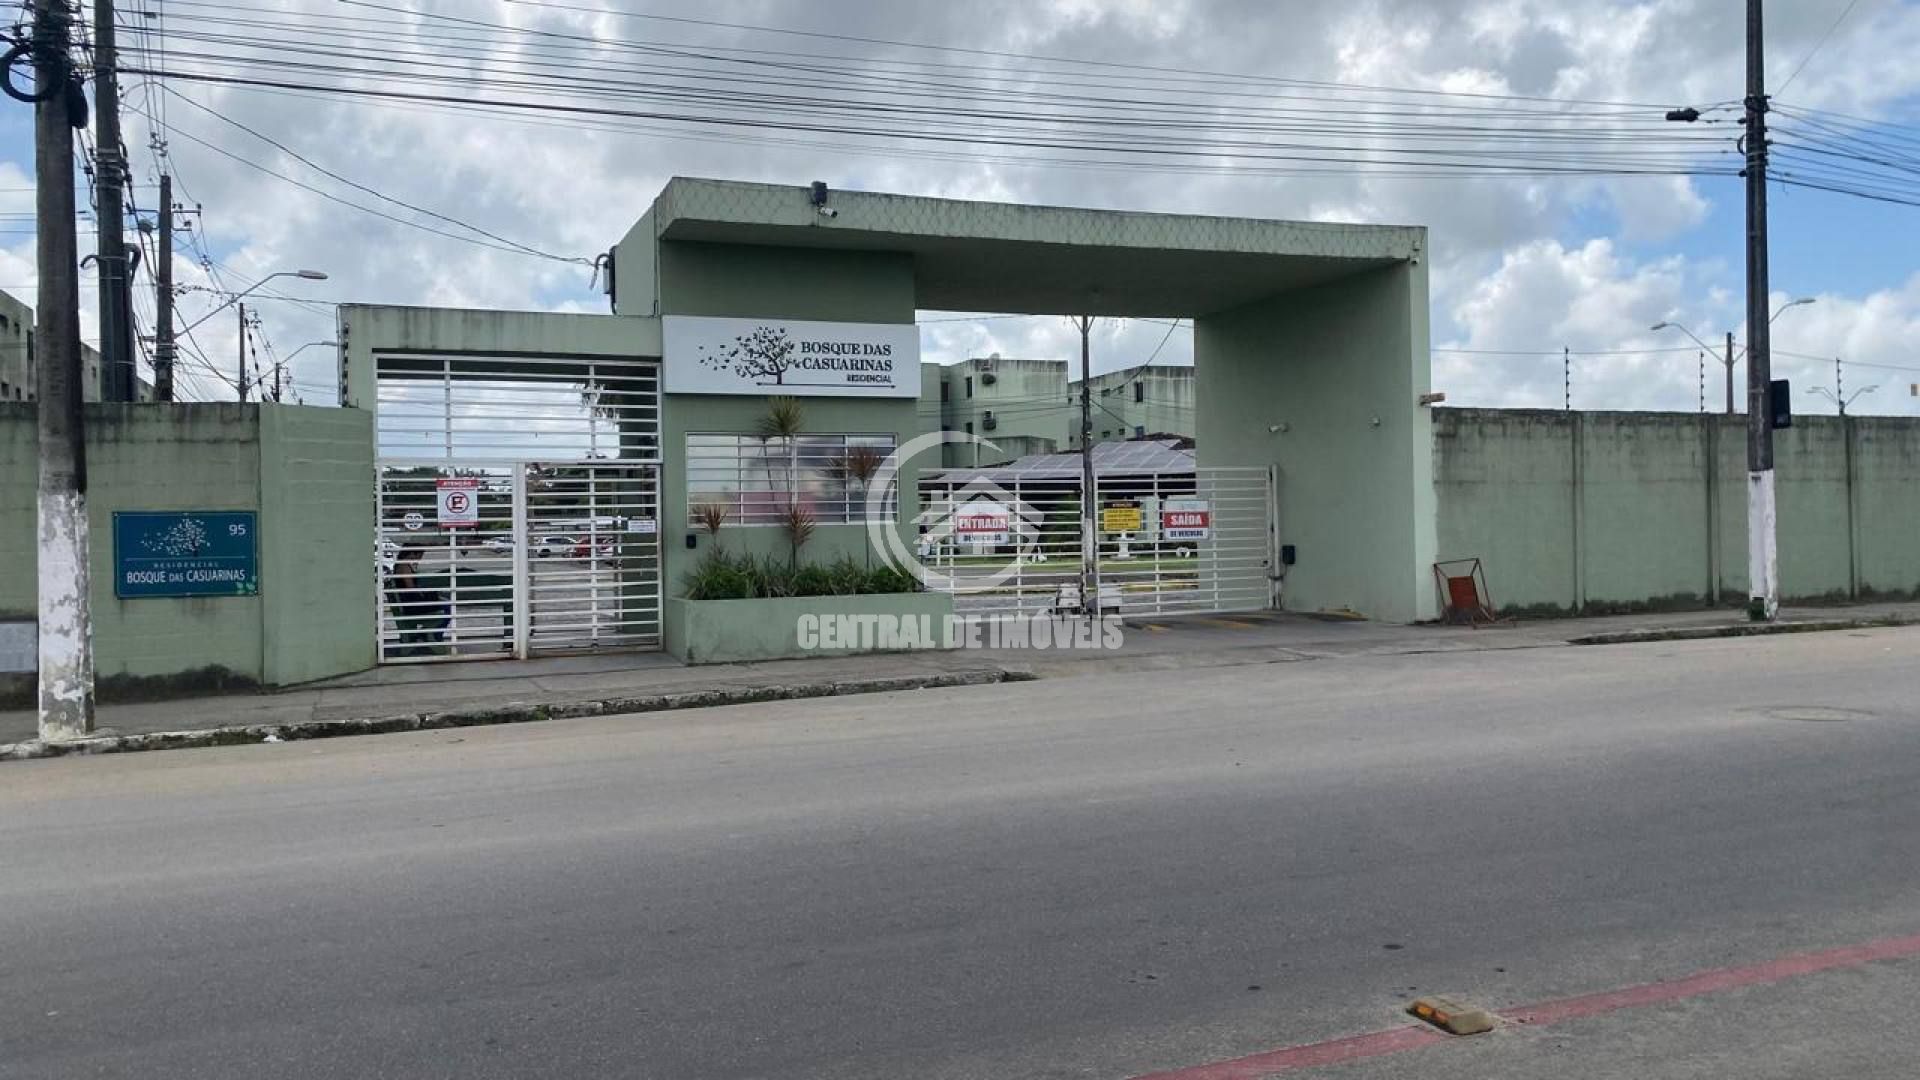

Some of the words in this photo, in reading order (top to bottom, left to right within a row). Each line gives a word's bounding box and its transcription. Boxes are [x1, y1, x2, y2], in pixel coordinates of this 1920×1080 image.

[801, 341, 860, 356] BOSQUE
[863, 343, 892, 356] DAS
[802, 357, 893, 372] CASUARINAS
[846, 374, 892, 383] RESIDENCIAL
[959, 518, 1006, 529] ENTRADA
[1170, 512, 1203, 526] SAÍDA
[228, 524, 247, 536] 95
[126, 570, 166, 584] BOSQUE
[168, 573, 184, 582] DAS
[186, 569, 246, 582] CASUARINAS
